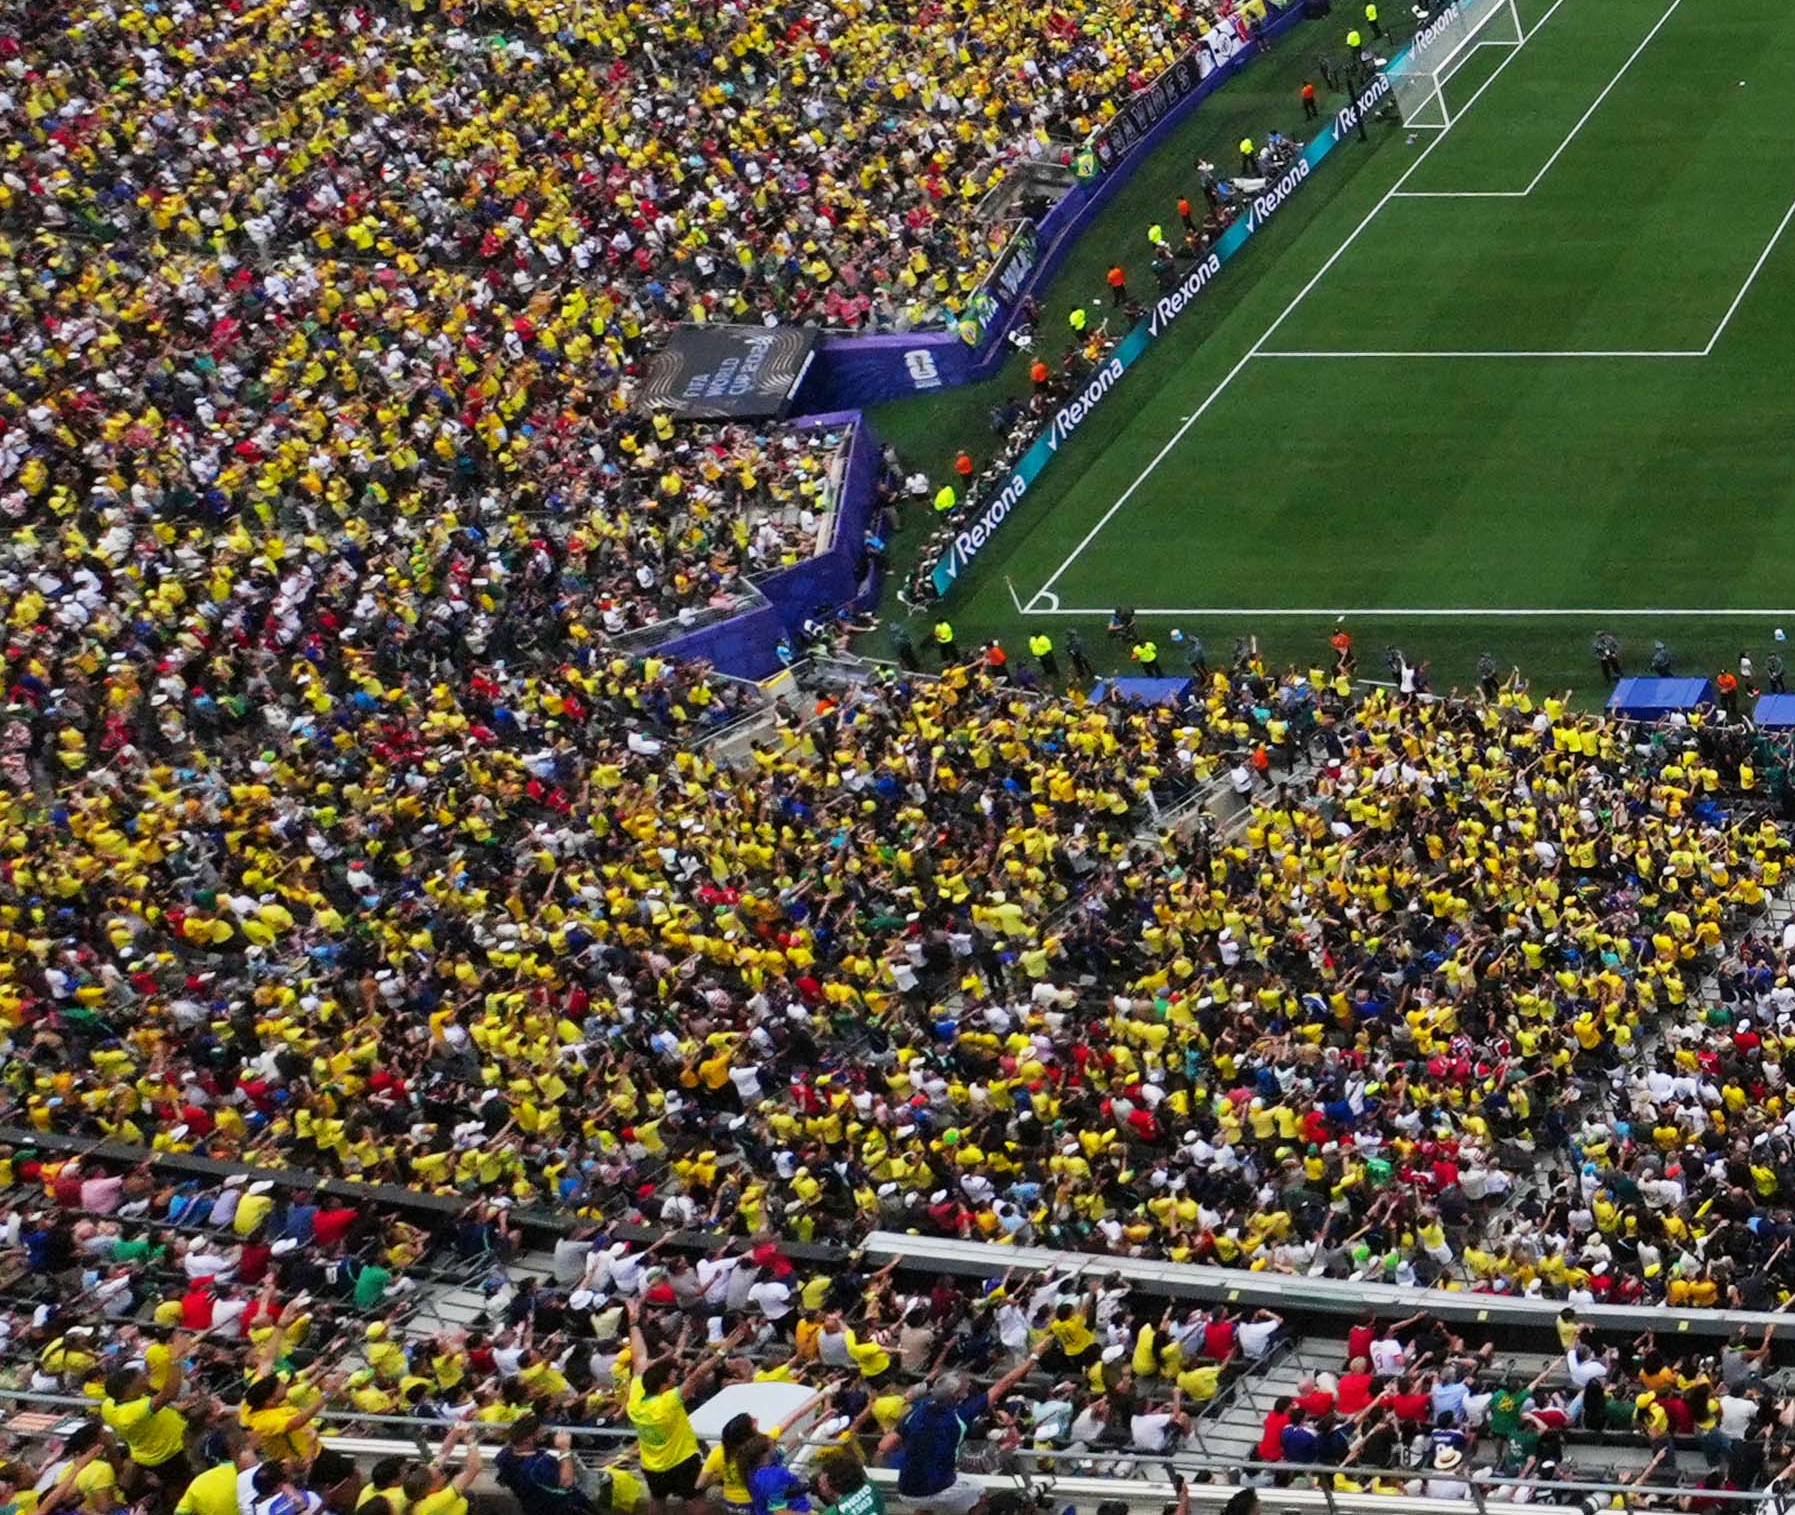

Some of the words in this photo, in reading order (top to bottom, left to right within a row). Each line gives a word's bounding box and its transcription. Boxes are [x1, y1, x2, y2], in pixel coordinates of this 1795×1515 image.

[1253, 157, 1310, 223] Rexona
[1158, 251, 1221, 325] Rexona
[1057, 355, 1124, 442] Rexona
[954, 472, 1027, 565] Rexona
